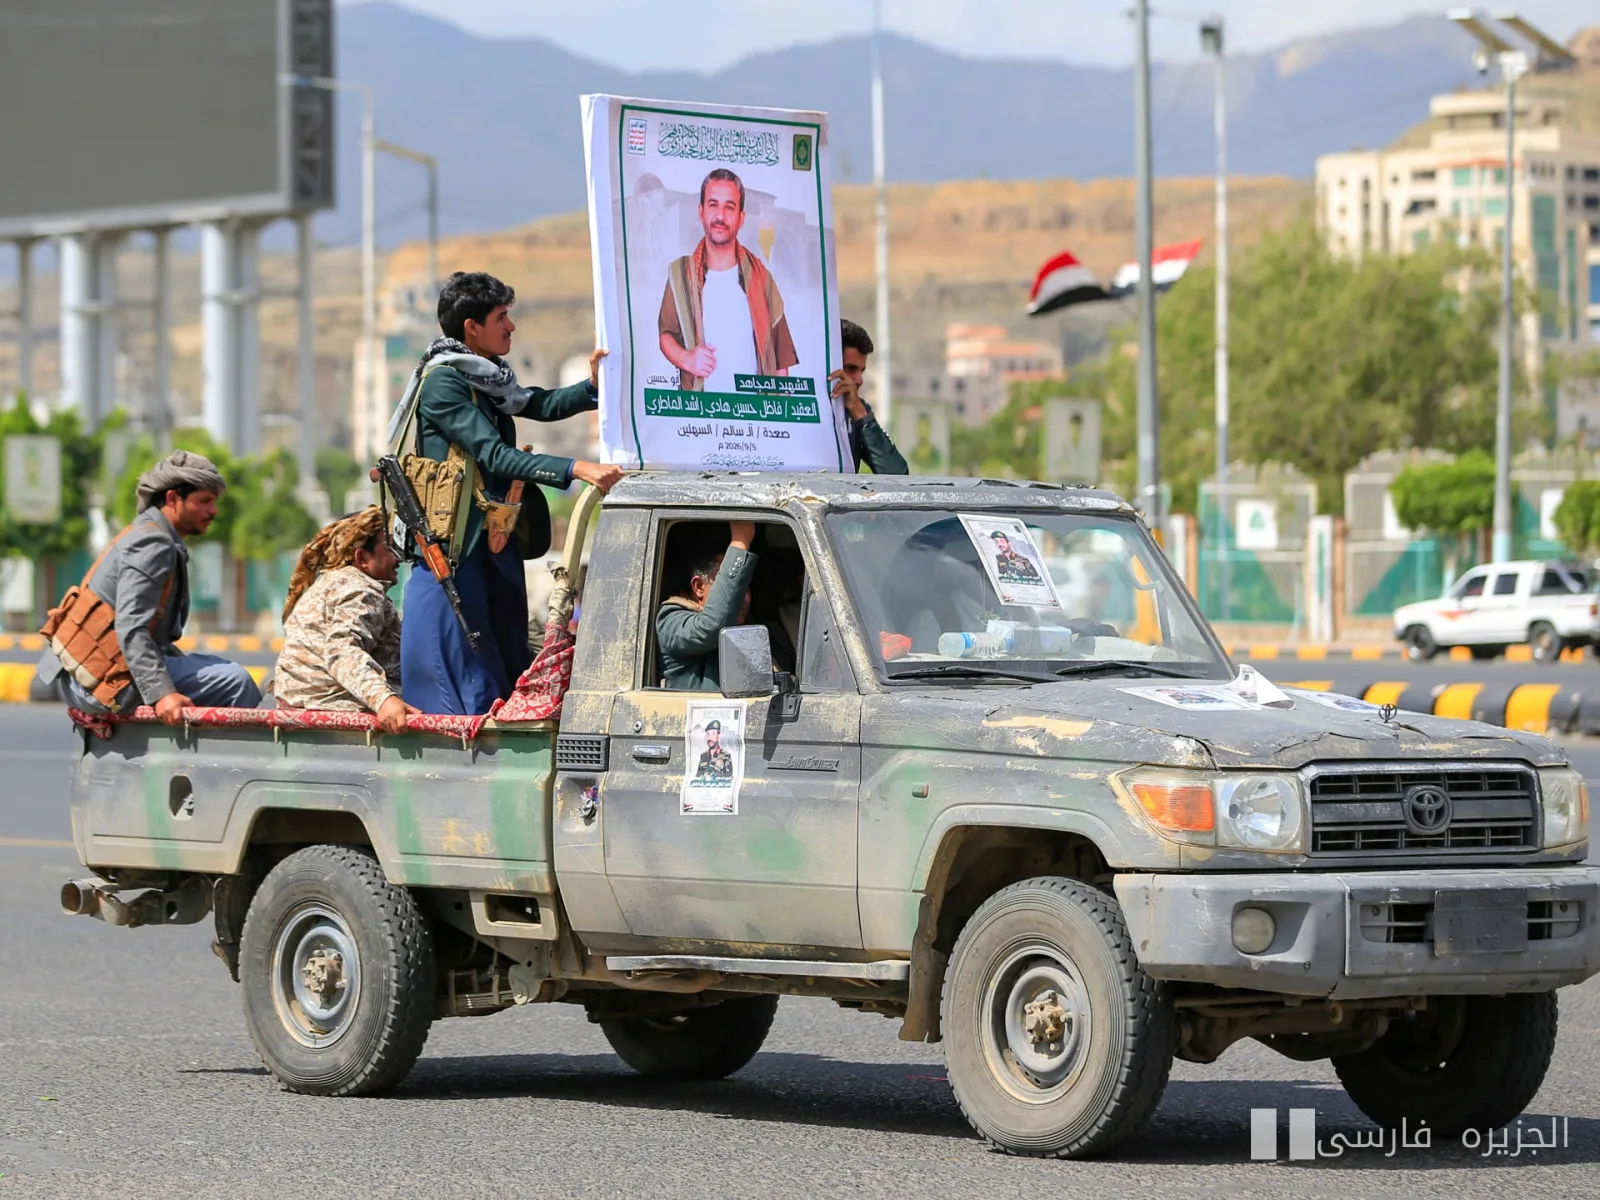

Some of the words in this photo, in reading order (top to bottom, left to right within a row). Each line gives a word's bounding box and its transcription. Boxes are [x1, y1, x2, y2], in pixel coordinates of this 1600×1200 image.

[646, 374, 669, 386] حسين
[739, 376, 777, 393] المجاهد
[778, 378, 809, 394] الشهيد
[646, 394, 683, 415] الماطري
[684, 394, 704, 416] راشد
[704, 397, 731, 418] هادي
[731, 402, 758, 418] حسين
[790, 401, 818, 421] العقيد
[677, 422, 713, 438] السهلين
[722, 424, 744, 438] سالم
[762, 426, 791, 439] صعدة
[718, 442, 724, 452] م
